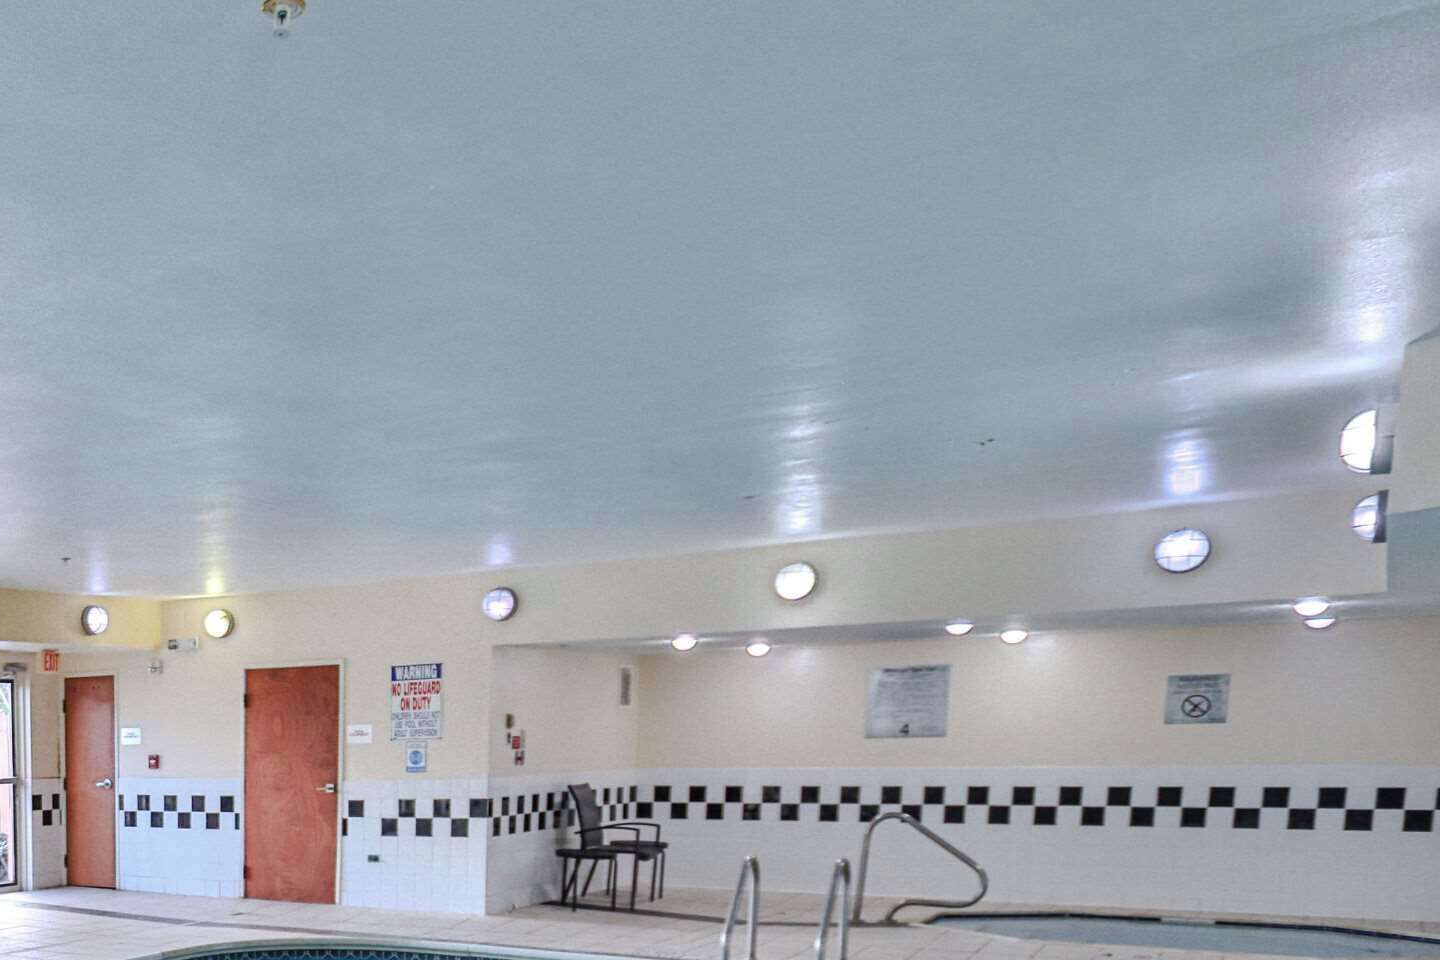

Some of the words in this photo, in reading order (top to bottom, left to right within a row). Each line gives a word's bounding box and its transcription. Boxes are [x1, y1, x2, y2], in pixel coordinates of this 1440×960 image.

[44, 652, 58, 672] EXIT
[395, 664, 437, 680] WARNING
[391, 683, 401, 697] NO
[403, 680, 441, 696] LIFEGUARD
[400, 697, 410, 711] ON
[412, 696, 431, 711] DUTY
